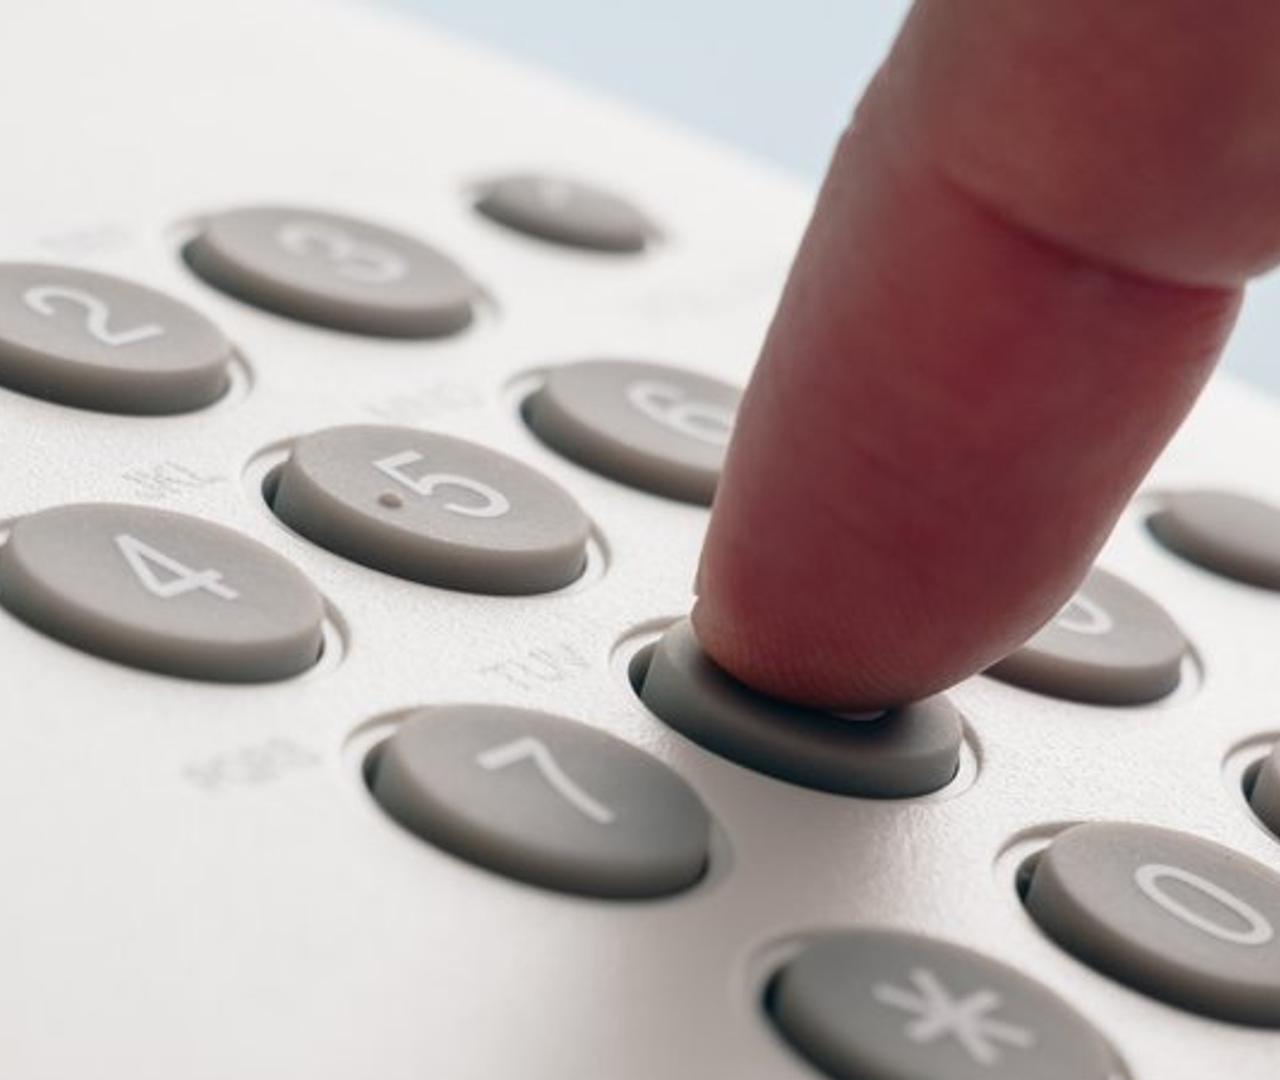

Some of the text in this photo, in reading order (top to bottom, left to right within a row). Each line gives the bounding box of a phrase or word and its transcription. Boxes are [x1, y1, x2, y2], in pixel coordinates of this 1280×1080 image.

[276, 221, 407, 283] 3
[24, 284, 165, 346] 2
[624, 380, 734, 446] 6
[372, 451, 509, 519] 5
[114, 533, 239, 600] 4
[475, 736, 615, 824] 7
[1133, 864, 1275, 946] 0
